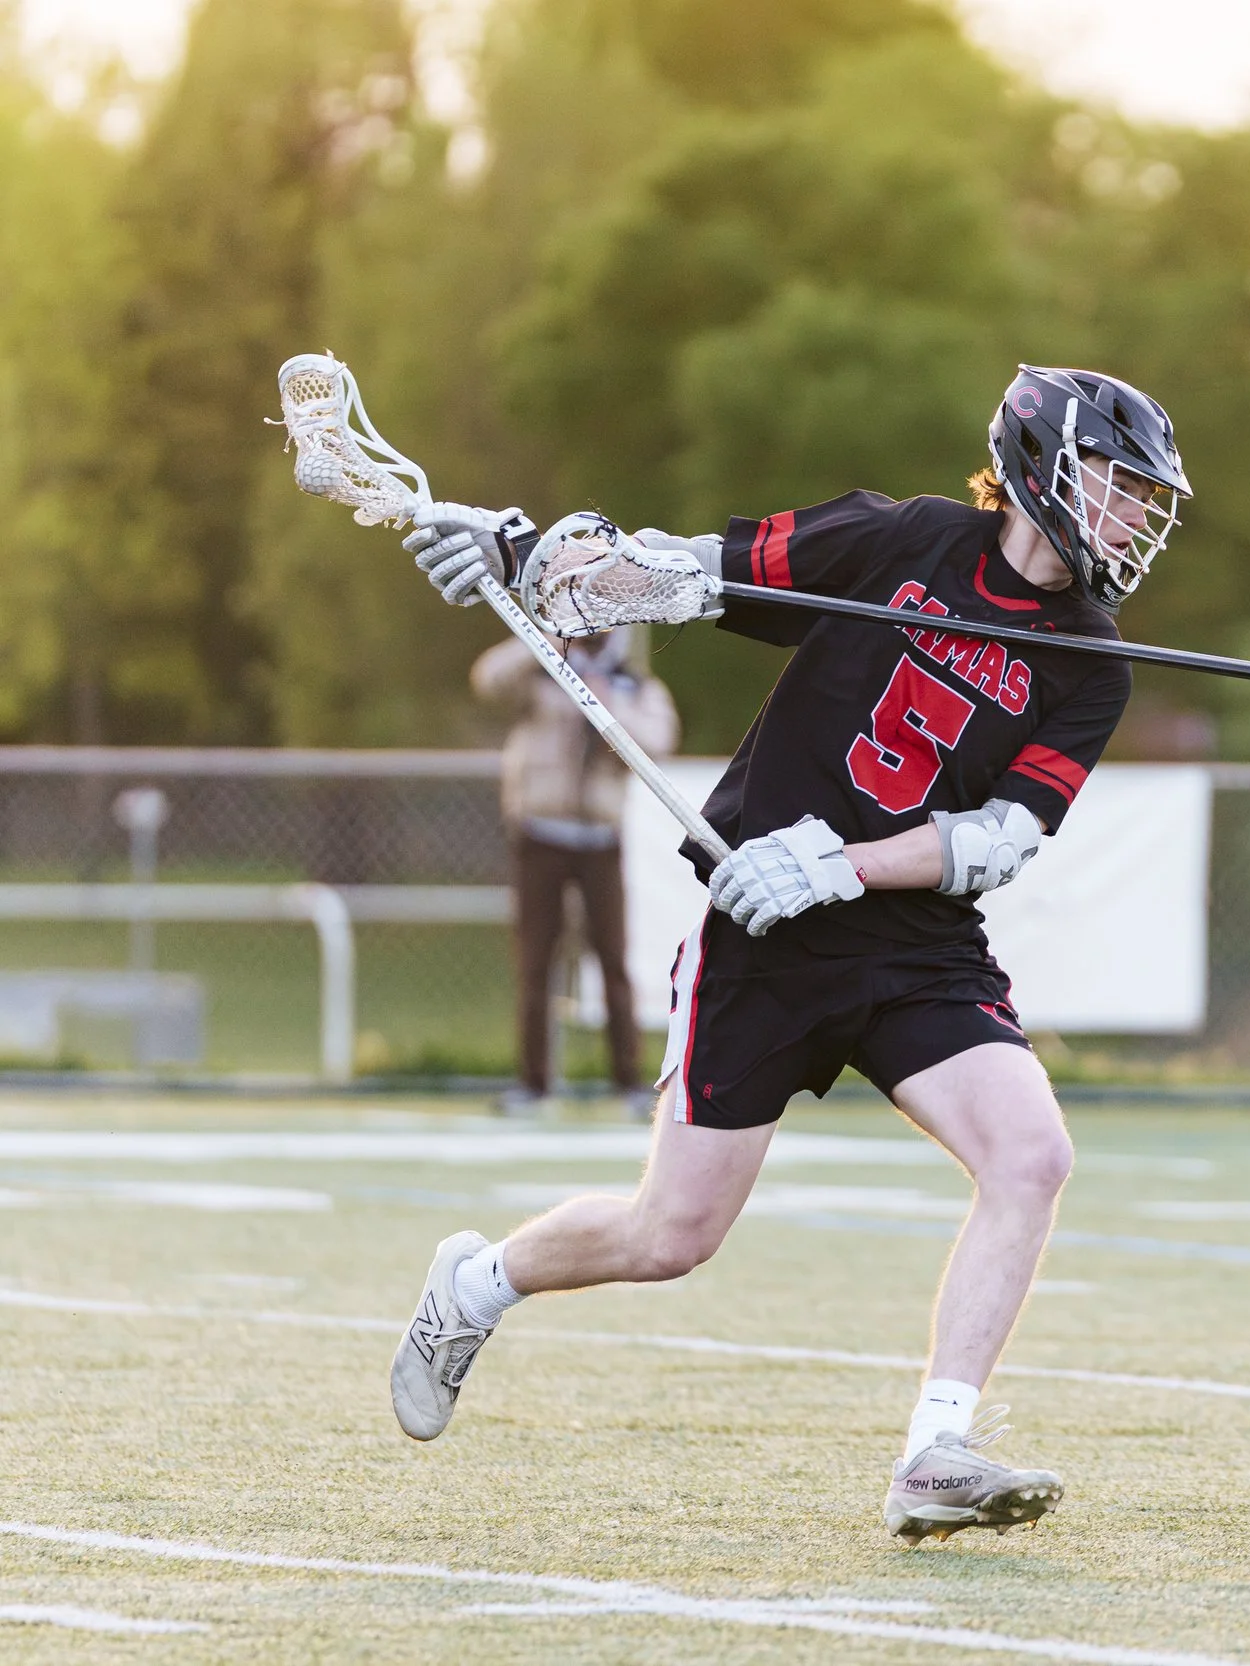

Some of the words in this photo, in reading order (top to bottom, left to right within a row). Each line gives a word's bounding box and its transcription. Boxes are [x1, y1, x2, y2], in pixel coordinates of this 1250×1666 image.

[1012, 385, 1043, 419] C
[886, 579, 1032, 717] CAMAS
[845, 651, 977, 816] 5
[905, 1478, 930, 1490] new
[931, 1473, 983, 1490] balance
